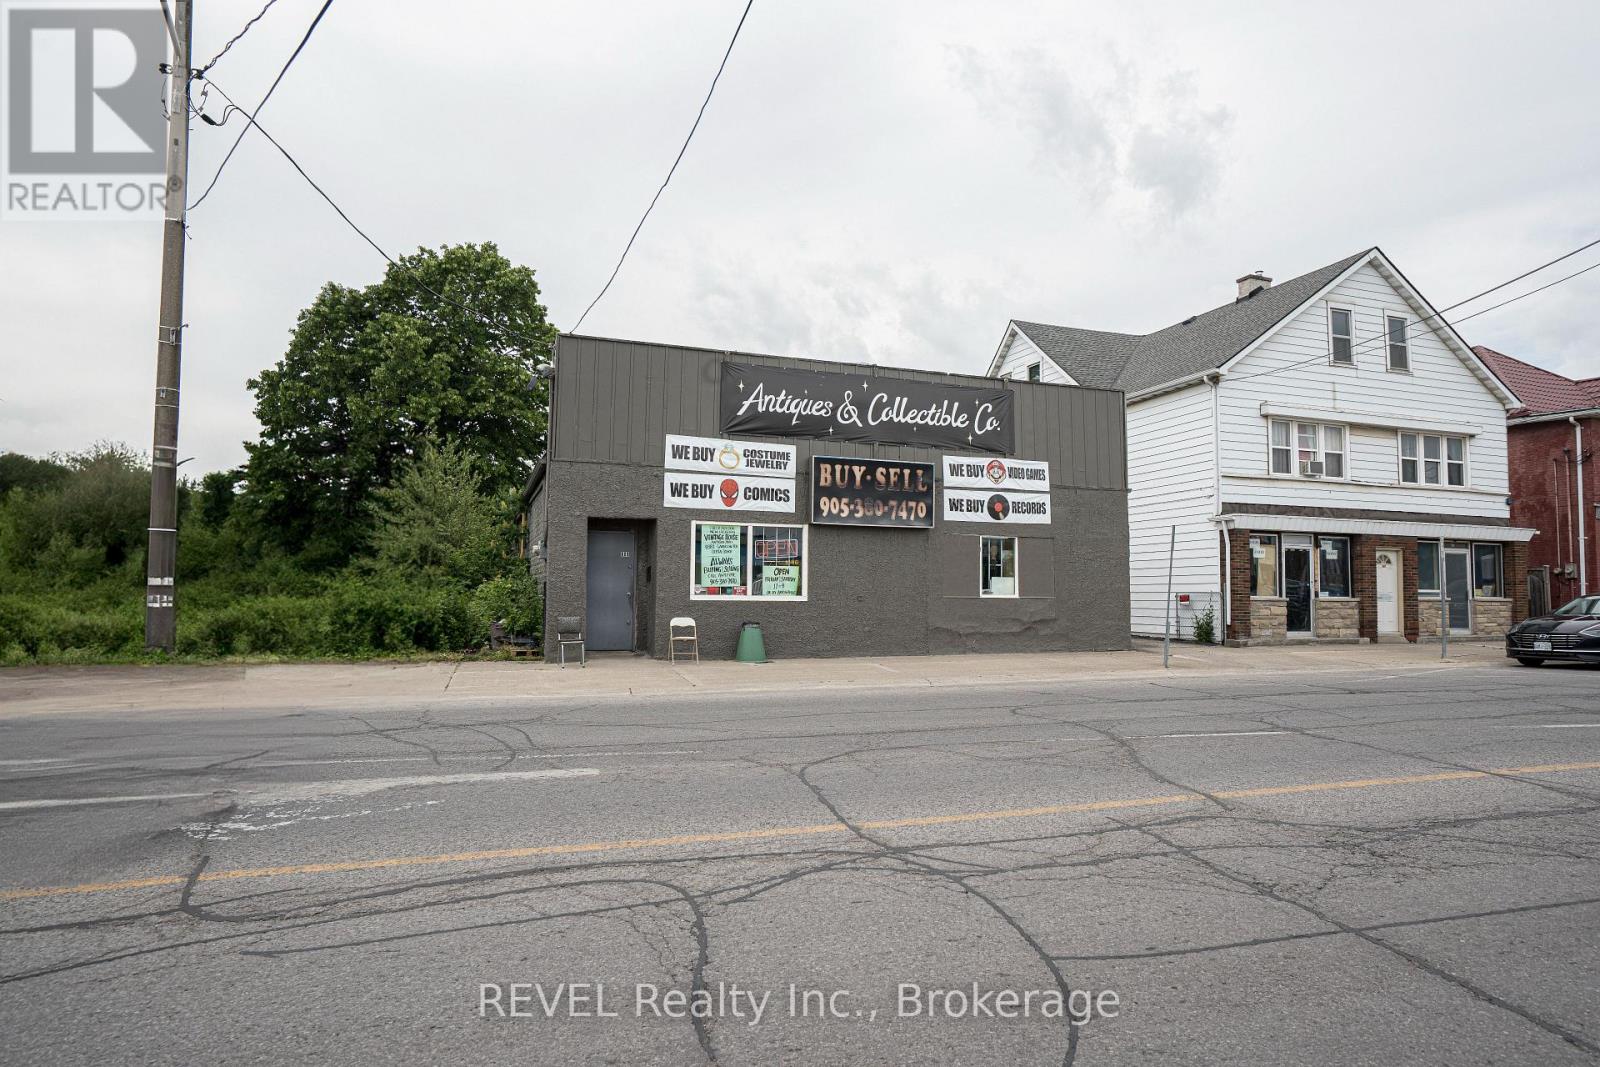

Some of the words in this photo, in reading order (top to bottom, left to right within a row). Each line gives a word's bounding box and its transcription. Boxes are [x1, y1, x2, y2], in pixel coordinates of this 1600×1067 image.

[736, 382, 832, 425] Antiques
[836, 390, 862, 427] &
[867, 392, 969, 428] Collectible
[974, 402, 1002, 435] Co.
[671, 444, 690, 460] WE
[692, 446, 716, 462] BUY
[743, 448, 791, 461] COSTUME
[745, 459, 788, 470] JEWELRY
[949, 463, 965, 477] WE
[966, 464, 985, 478] BUY
[1008, 466, 1025, 480] VIDEO
[1026, 468, 1046, 481] GAMES
[670, 482, 689, 498] WE
[691, 483, 715, 499] BUY
[743, 487, 790, 503] COMICS
[949, 498, 965, 512] WE
[966, 499, 985, 513] BUY
[1012, 501, 1047, 515] RECORDS
[756, 541, 798, 557] OPEN
[773, 567, 790, 577] OPEN
